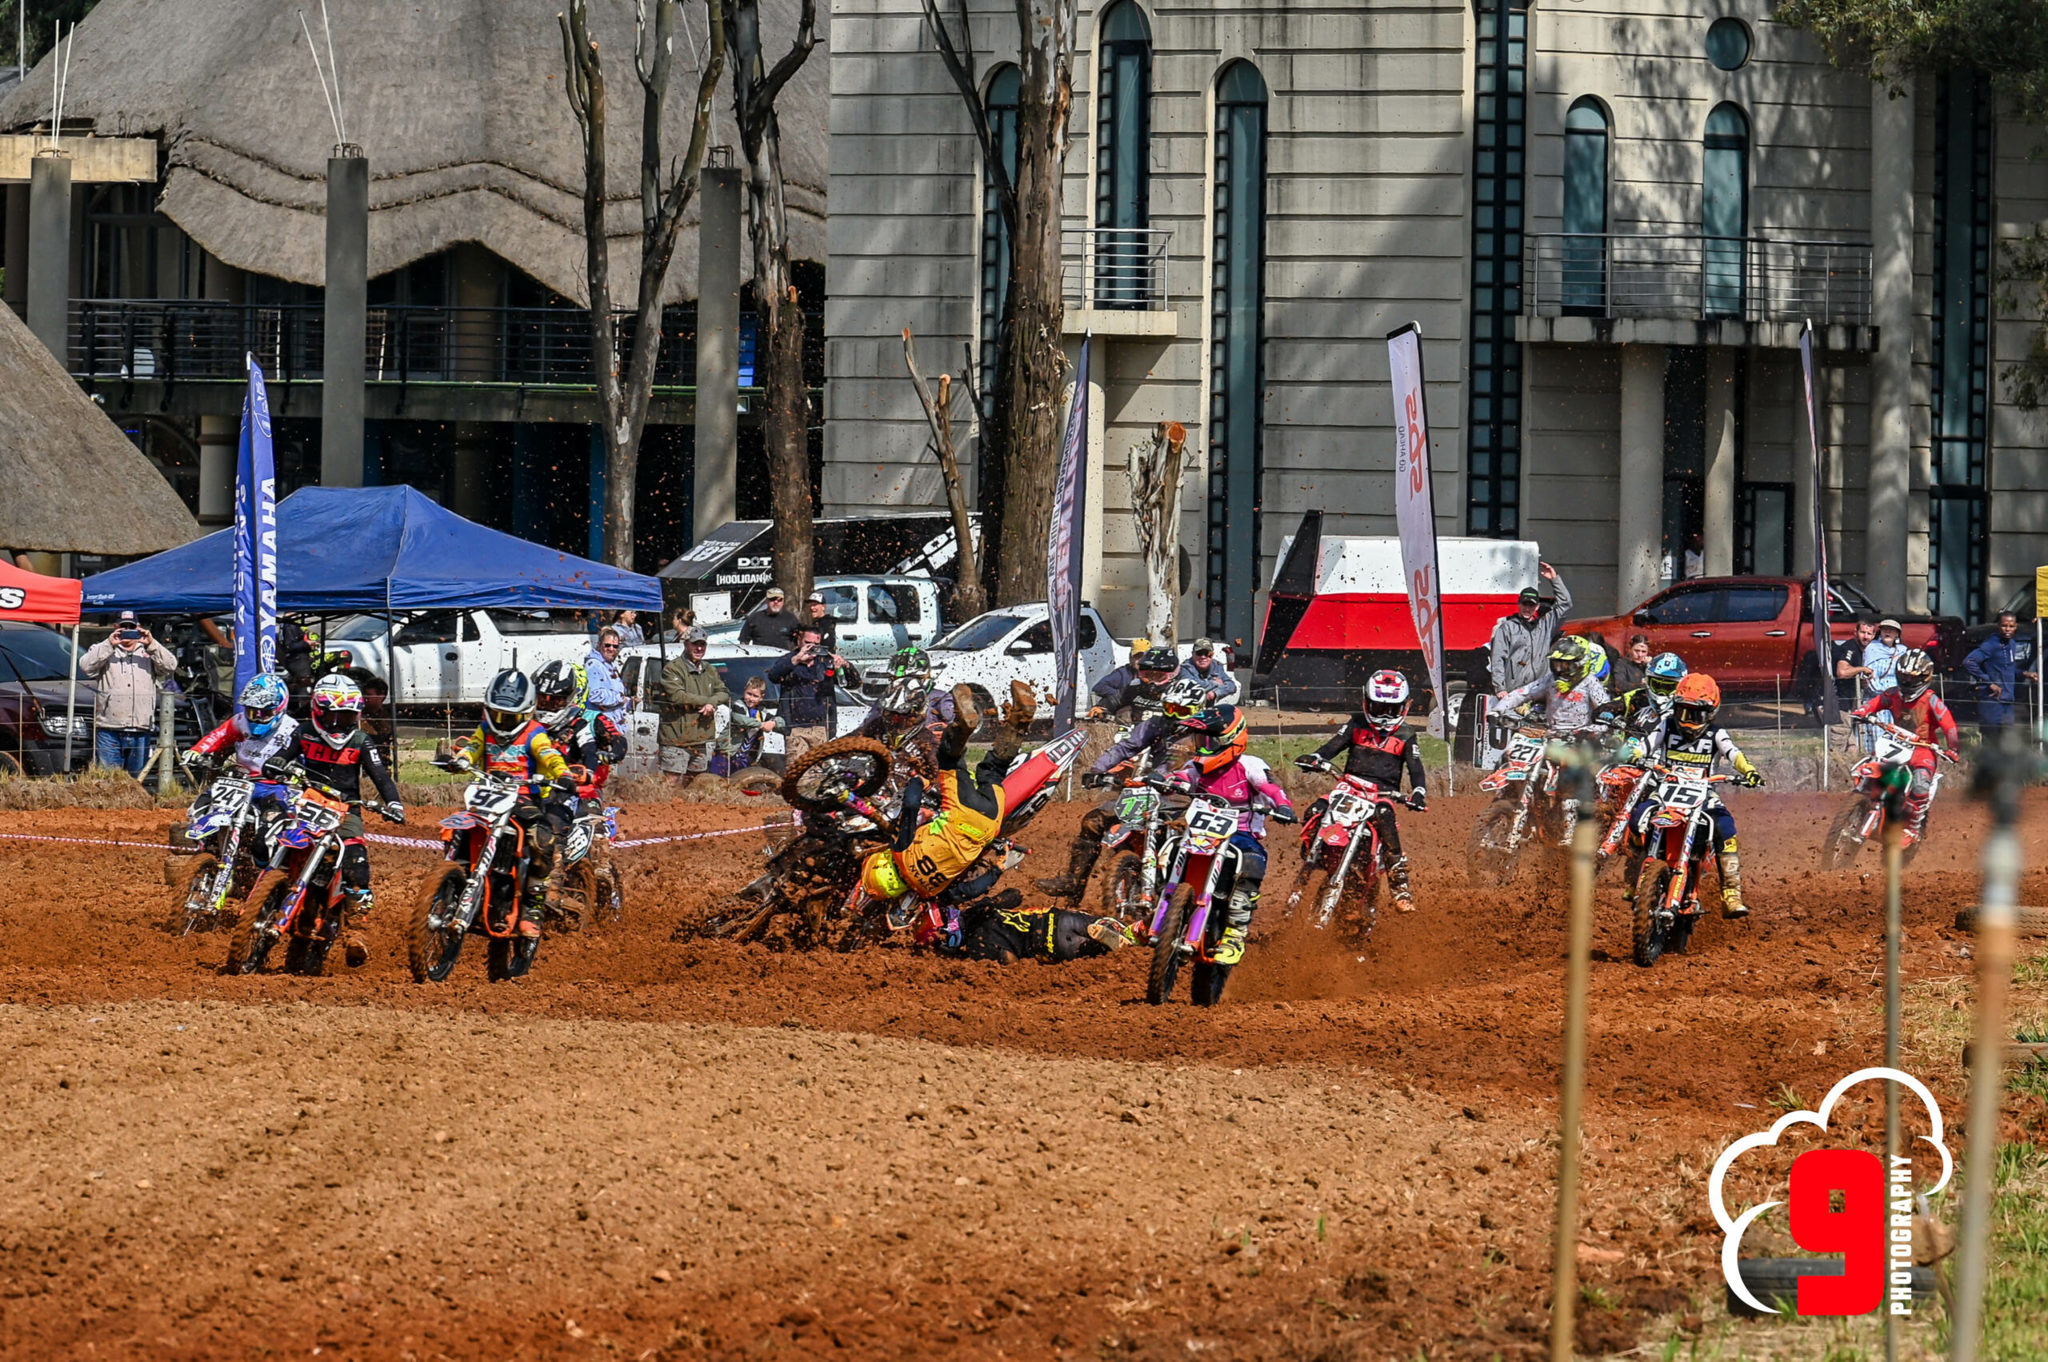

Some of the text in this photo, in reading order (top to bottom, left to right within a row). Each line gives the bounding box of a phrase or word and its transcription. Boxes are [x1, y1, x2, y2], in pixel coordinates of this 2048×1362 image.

[260, 478, 276, 630] YAMAHA
[681, 545, 736, 562] 187
[738, 557, 772, 569] DOT
[1510, 744, 1539, 762] 221
[1882, 743, 1903, 759] 7
[212, 786, 248, 807] 247
[469, 789, 511, 808] 97
[1662, 784, 1702, 805] 15
[297, 802, 340, 829] 56
[1189, 811, 1233, 836] 63
